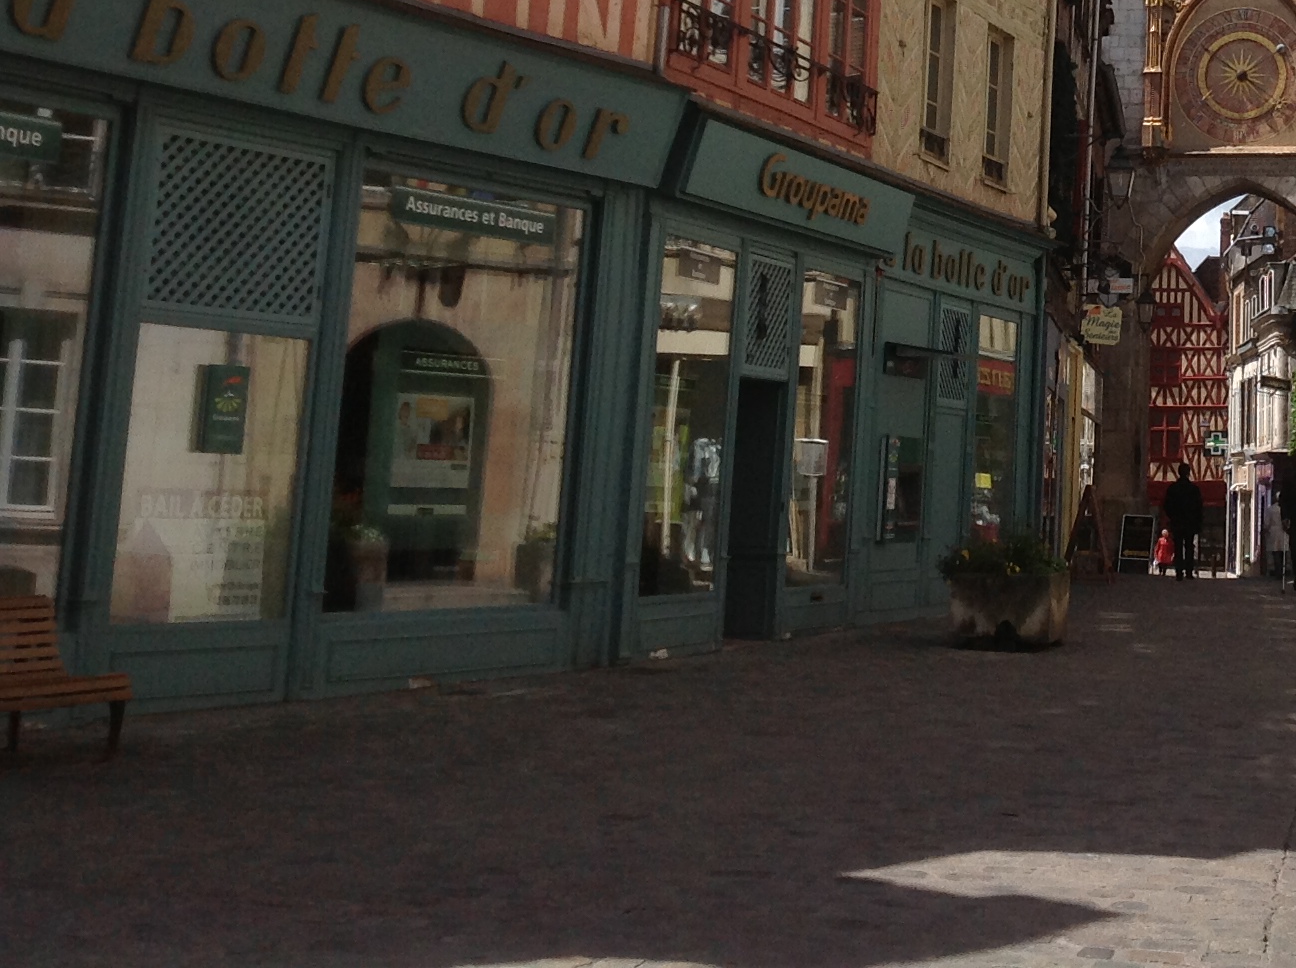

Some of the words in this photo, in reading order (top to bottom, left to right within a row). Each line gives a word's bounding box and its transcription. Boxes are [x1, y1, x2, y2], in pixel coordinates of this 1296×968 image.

[460, 61, 630, 160] d'or
[759, 153, 870, 226] Groupama
[405, 196, 479, 223] Assurances
[482, 211, 496, 226] et
[498, 213, 545, 235] Banque
[903, 231, 927, 276] la
[930, 239, 987, 291] botte
[1086, 316, 1121, 332] Magie
[415, 357, 479, 371] ASSURANCES
[140, 494, 185, 518] BAIL
[207, 491, 264, 518] CÉDER
